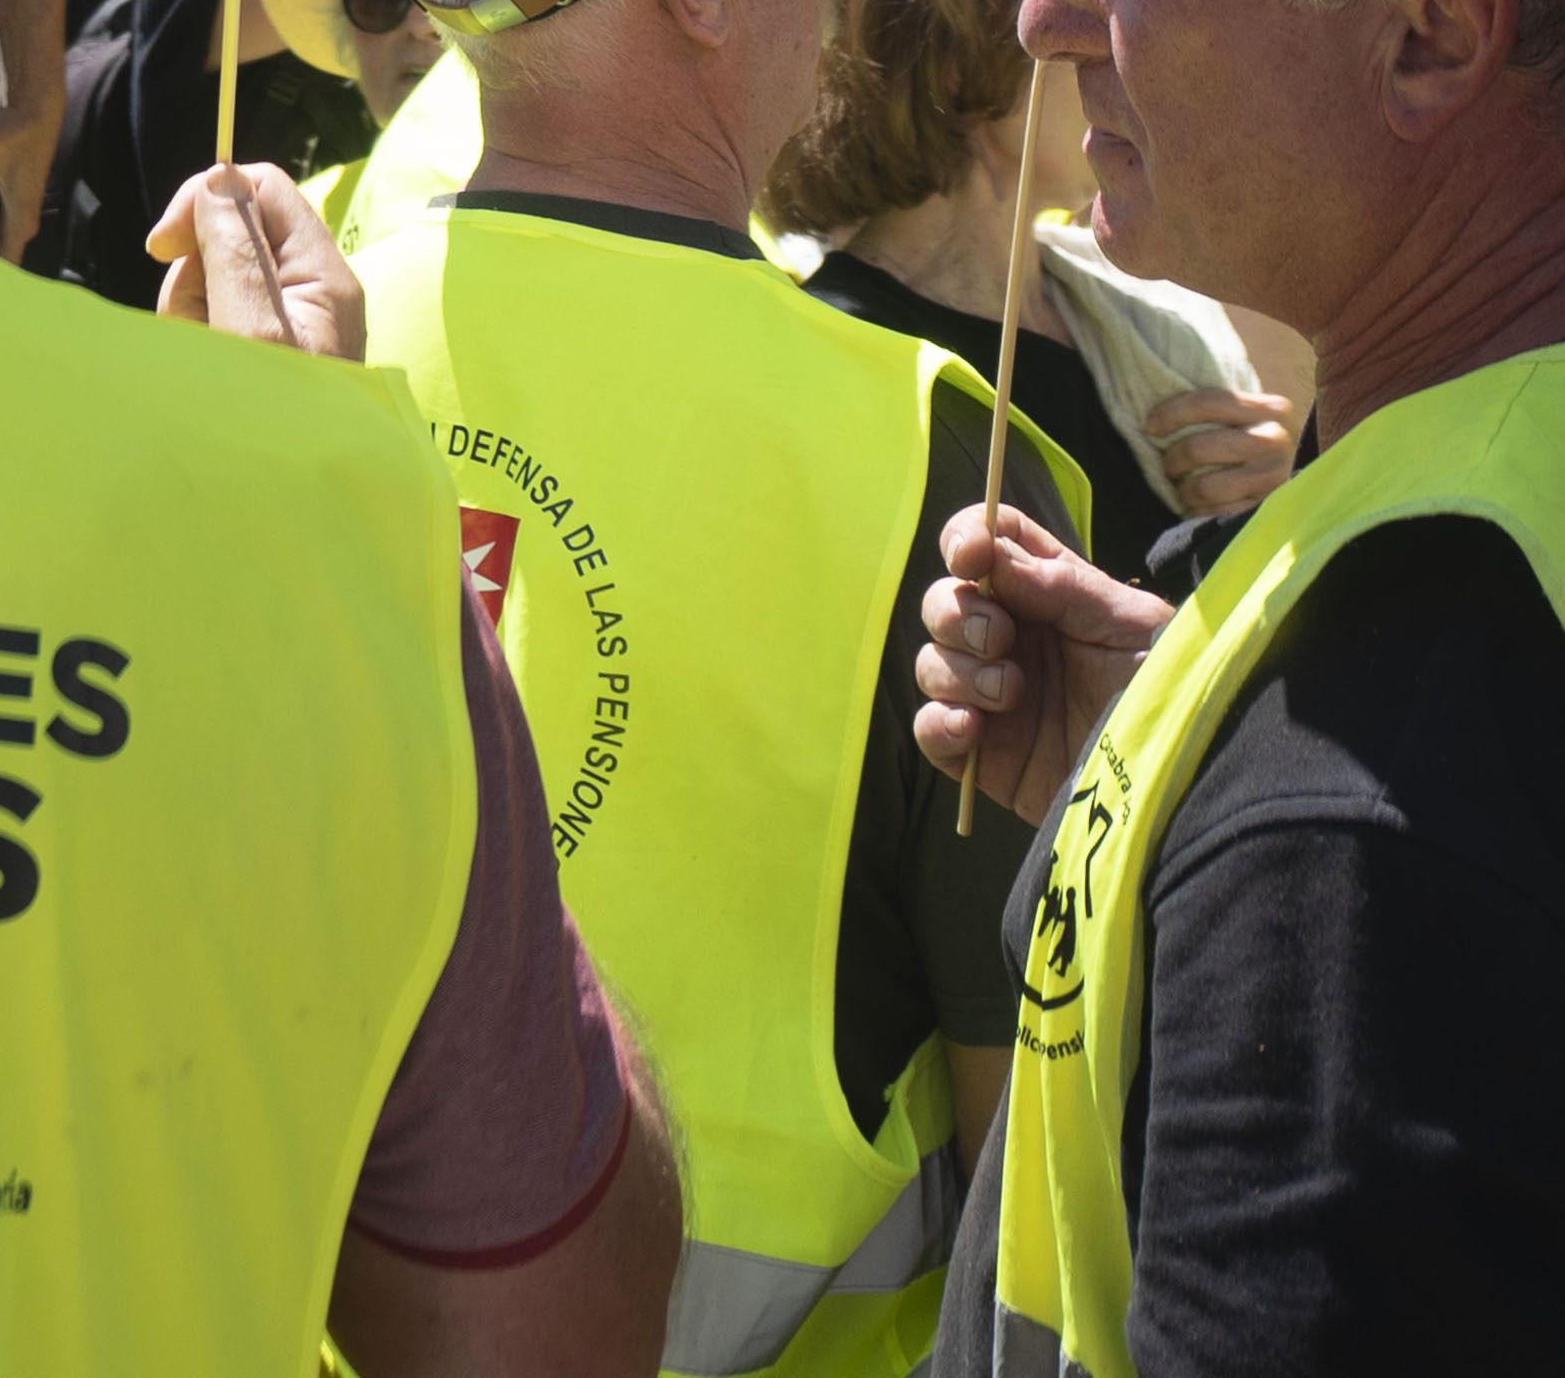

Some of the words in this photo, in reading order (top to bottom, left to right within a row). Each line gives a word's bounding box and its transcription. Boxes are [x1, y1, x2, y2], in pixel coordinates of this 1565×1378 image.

[448, 424, 575, 528] DEFENSA
[562, 523, 608, 578] DE
[585, 582, 629, 658] LAS
[550, 671, 630, 858] PENSIONE
